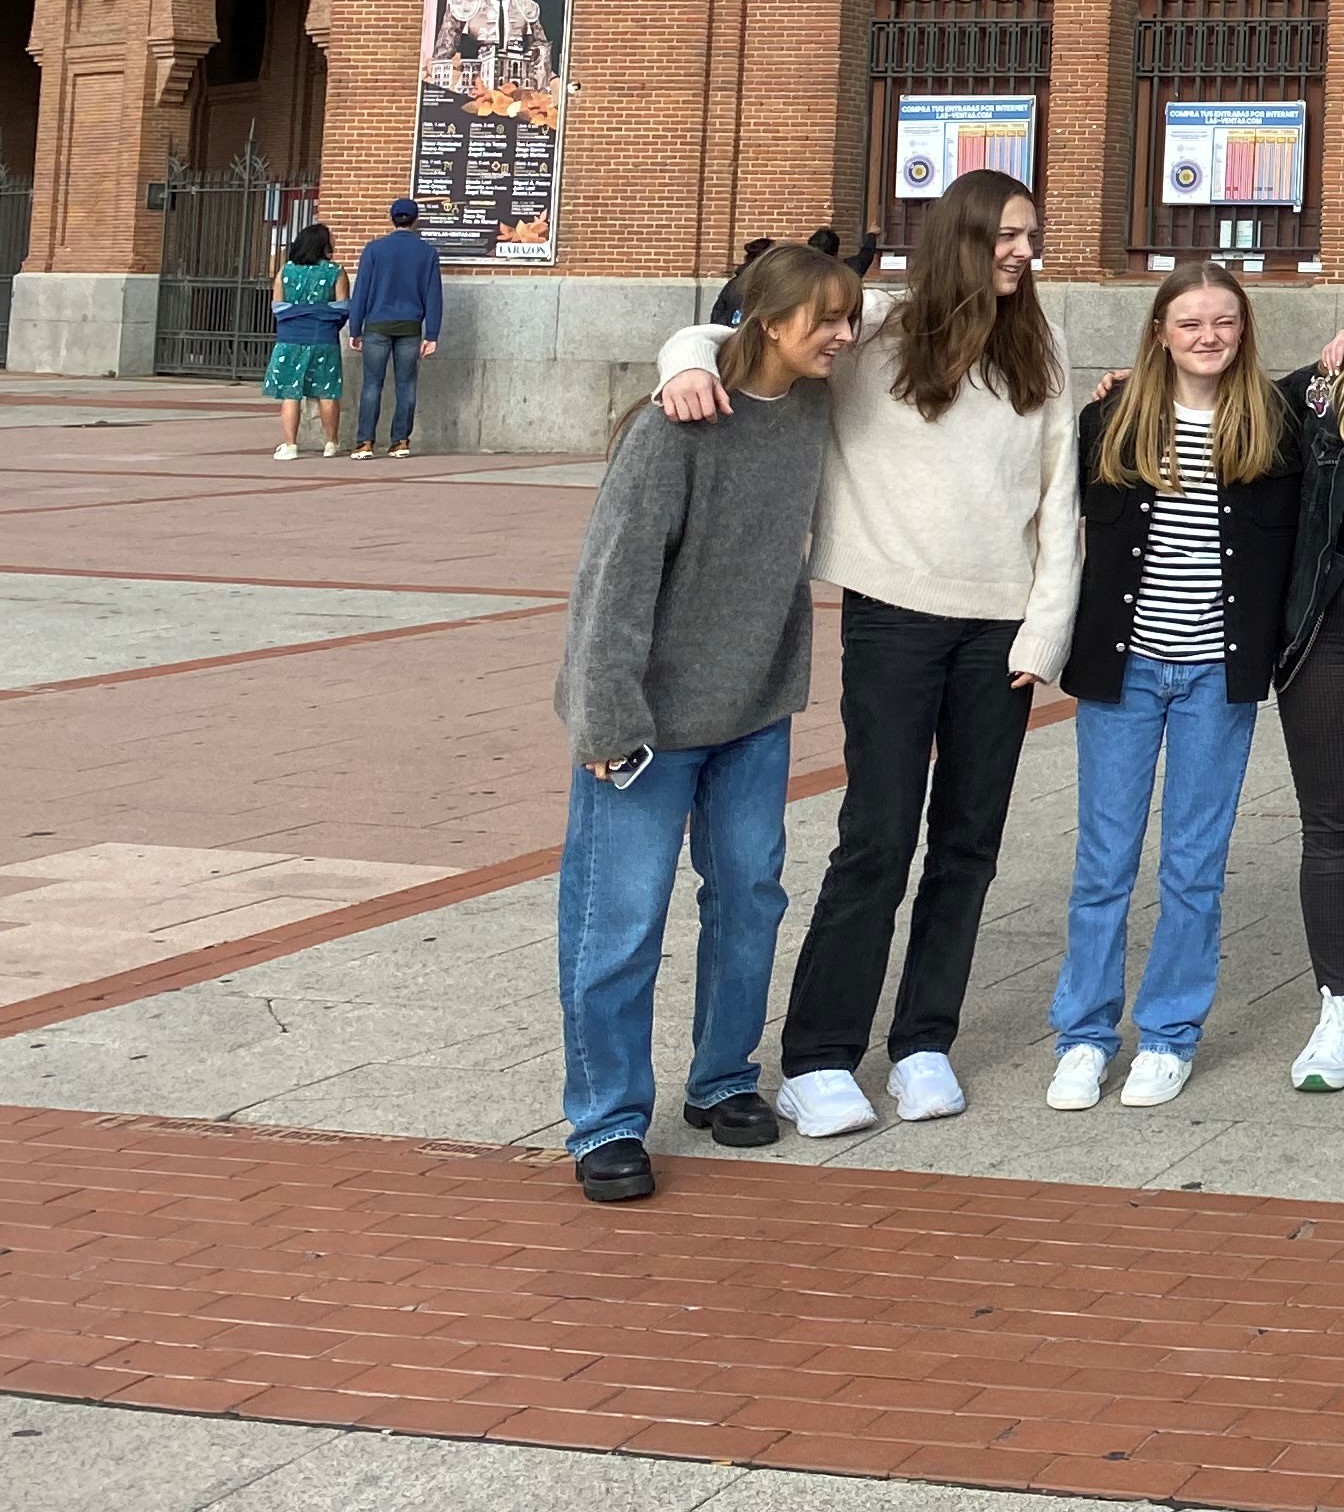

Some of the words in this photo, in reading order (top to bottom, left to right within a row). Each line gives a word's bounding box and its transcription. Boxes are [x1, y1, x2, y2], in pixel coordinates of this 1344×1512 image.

[901, 105, 930, 113] COMPRA
[931, 105, 944, 113] TUS
[1169, 110, 1200, 118] COMPRA
[1201, 110, 1214, 118] TUS
[1214, 110, 1249, 118] ENTRADAS
[1250, 110, 1264, 118] POR
[1266, 110, 1299, 118] INTERNET
